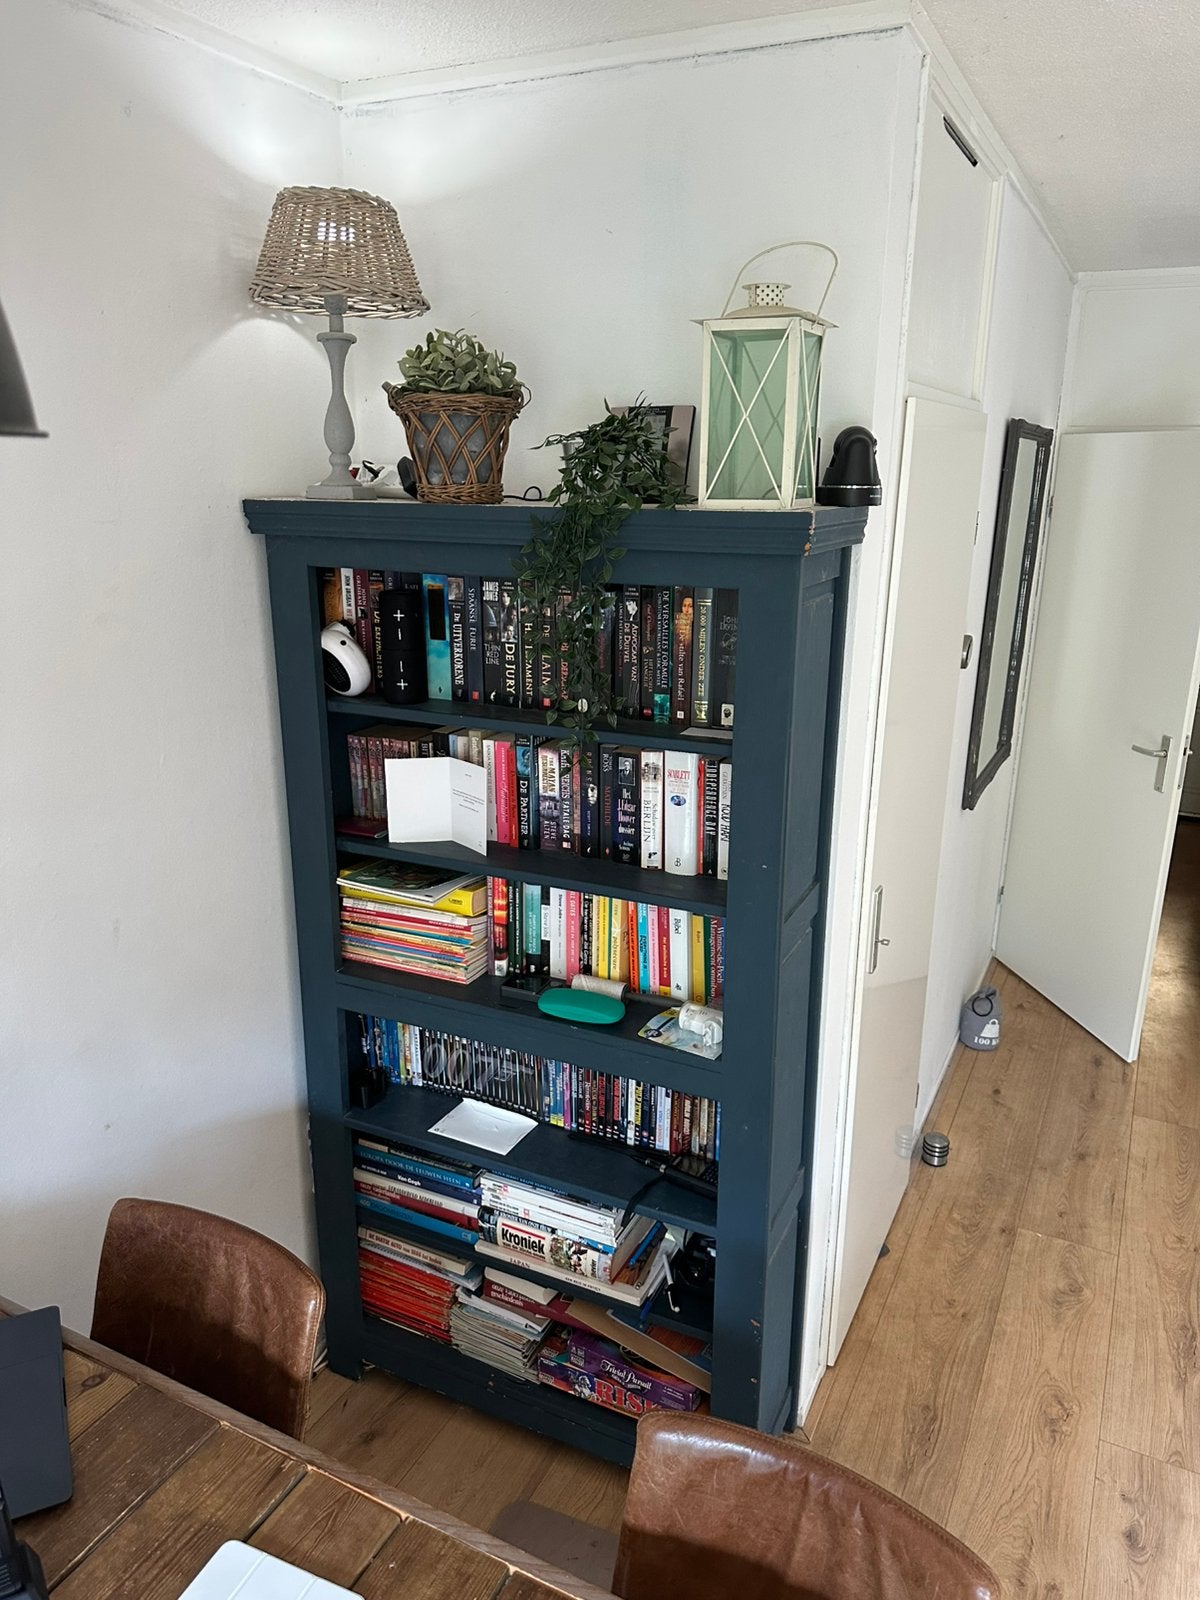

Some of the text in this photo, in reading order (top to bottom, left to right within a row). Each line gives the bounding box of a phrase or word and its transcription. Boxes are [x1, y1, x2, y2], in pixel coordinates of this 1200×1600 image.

[483, 581, 499, 591] JAMES
[483, 591, 499, 601] JONES
[468, 588, 476, 623] SPAANSE
[484, 643, 500, 651] THIN
[631, 623, 639, 664] ADVOCAAT
[661, 591, 669, 688] DE VERSAILLES FORMULE
[453, 624, 464, 685] UITVERKORENE
[505, 664, 516, 694] JURY
[667, 769, 690, 780] SCARLETT
[520, 780, 528, 835] DE PARTNER
[706, 761, 717, 836] INDEPENDENCE DAY
[974, 1036, 990, 1045] 100
[407, 1177, 421, 1186] Gogh
[502, 1228, 546, 1255] Kroniek
[510, 1258, 530, 1269] JAPAN
[601, 1360, 653, 1390] Trivial Pursuit
